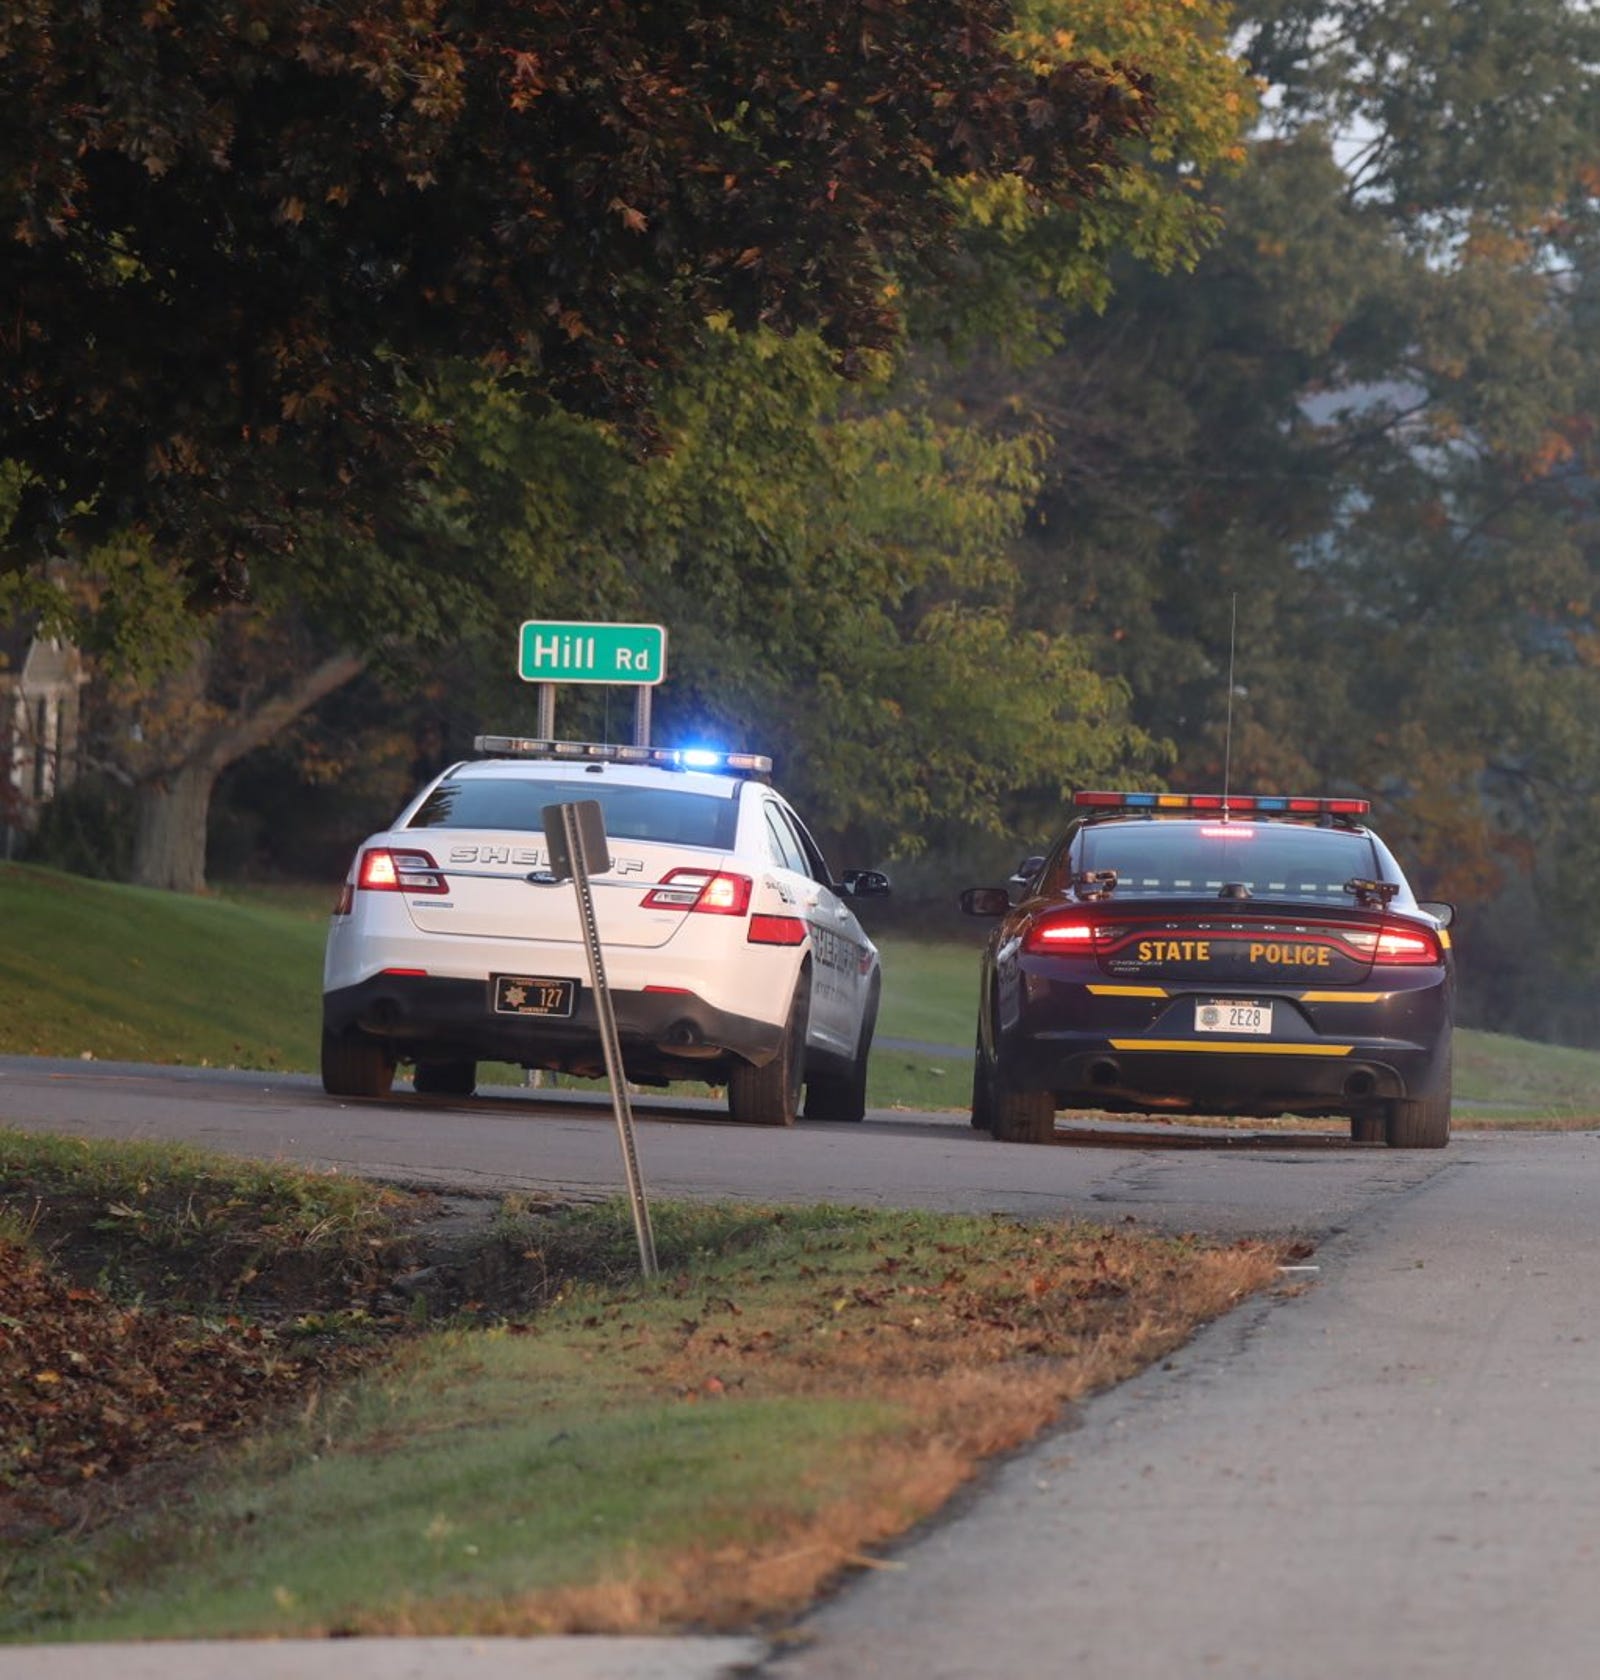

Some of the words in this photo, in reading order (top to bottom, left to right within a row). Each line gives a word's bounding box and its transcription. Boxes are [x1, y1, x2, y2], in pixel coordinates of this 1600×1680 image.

[534, 634, 595, 669] Hill
[616, 648, 649, 671] Rd
[450, 846, 644, 875] SHEF
[1139, 941, 1211, 961] STATE
[1249, 943, 1331, 966] POLICE
[540, 987, 563, 1008] 127
[1229, 1008, 1261, 1027] 2E28
